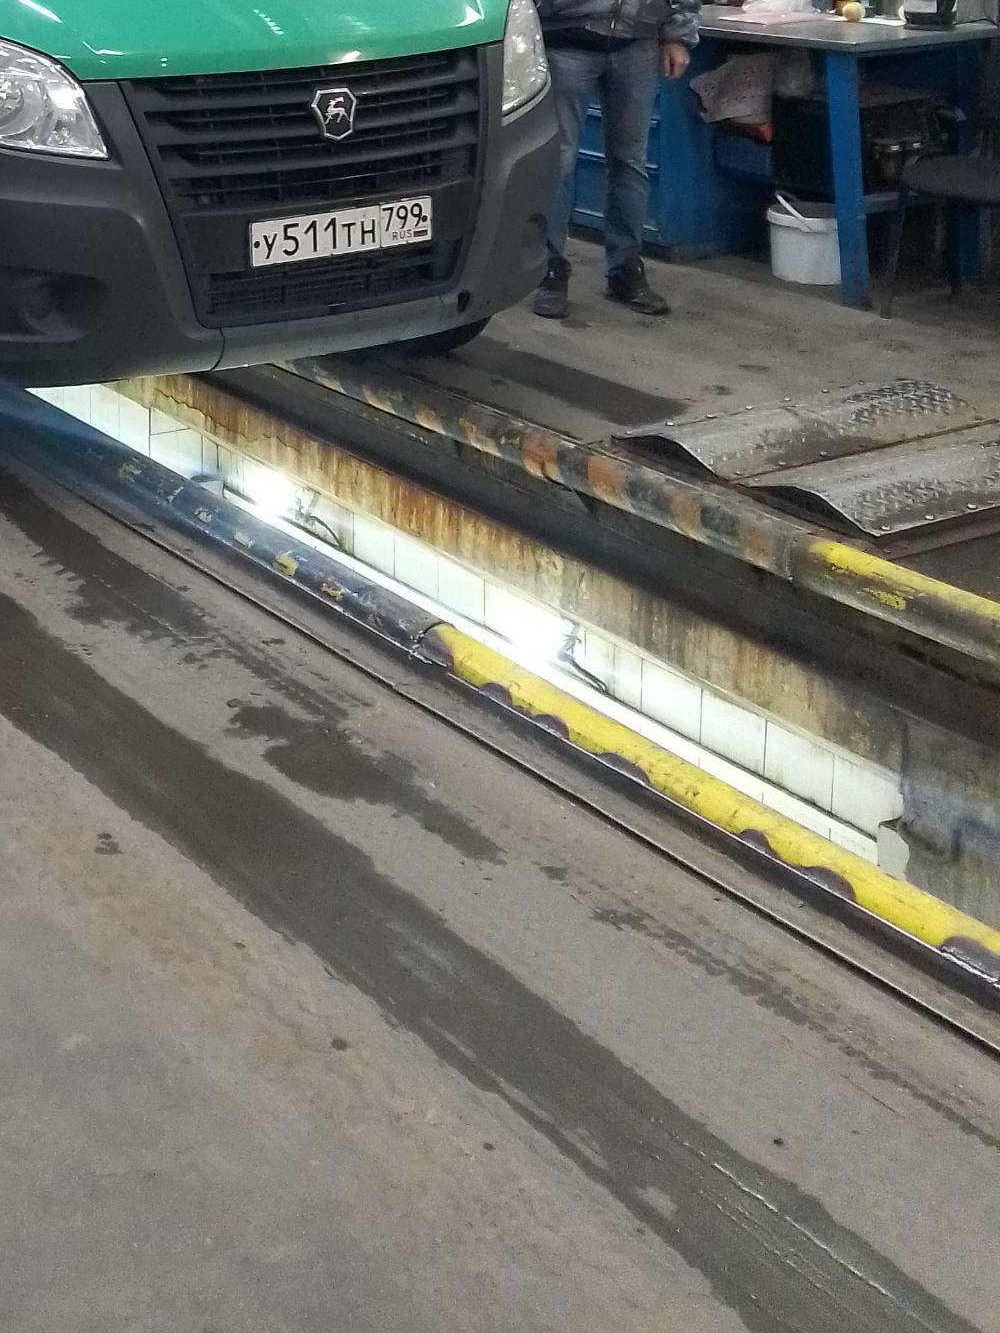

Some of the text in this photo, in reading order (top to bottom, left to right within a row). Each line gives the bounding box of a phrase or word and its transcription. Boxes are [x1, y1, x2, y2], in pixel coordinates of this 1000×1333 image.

[382, 202, 423, 232] 799
[262, 217, 376, 259] У511ТН
[392, 229, 412, 240] RUS
